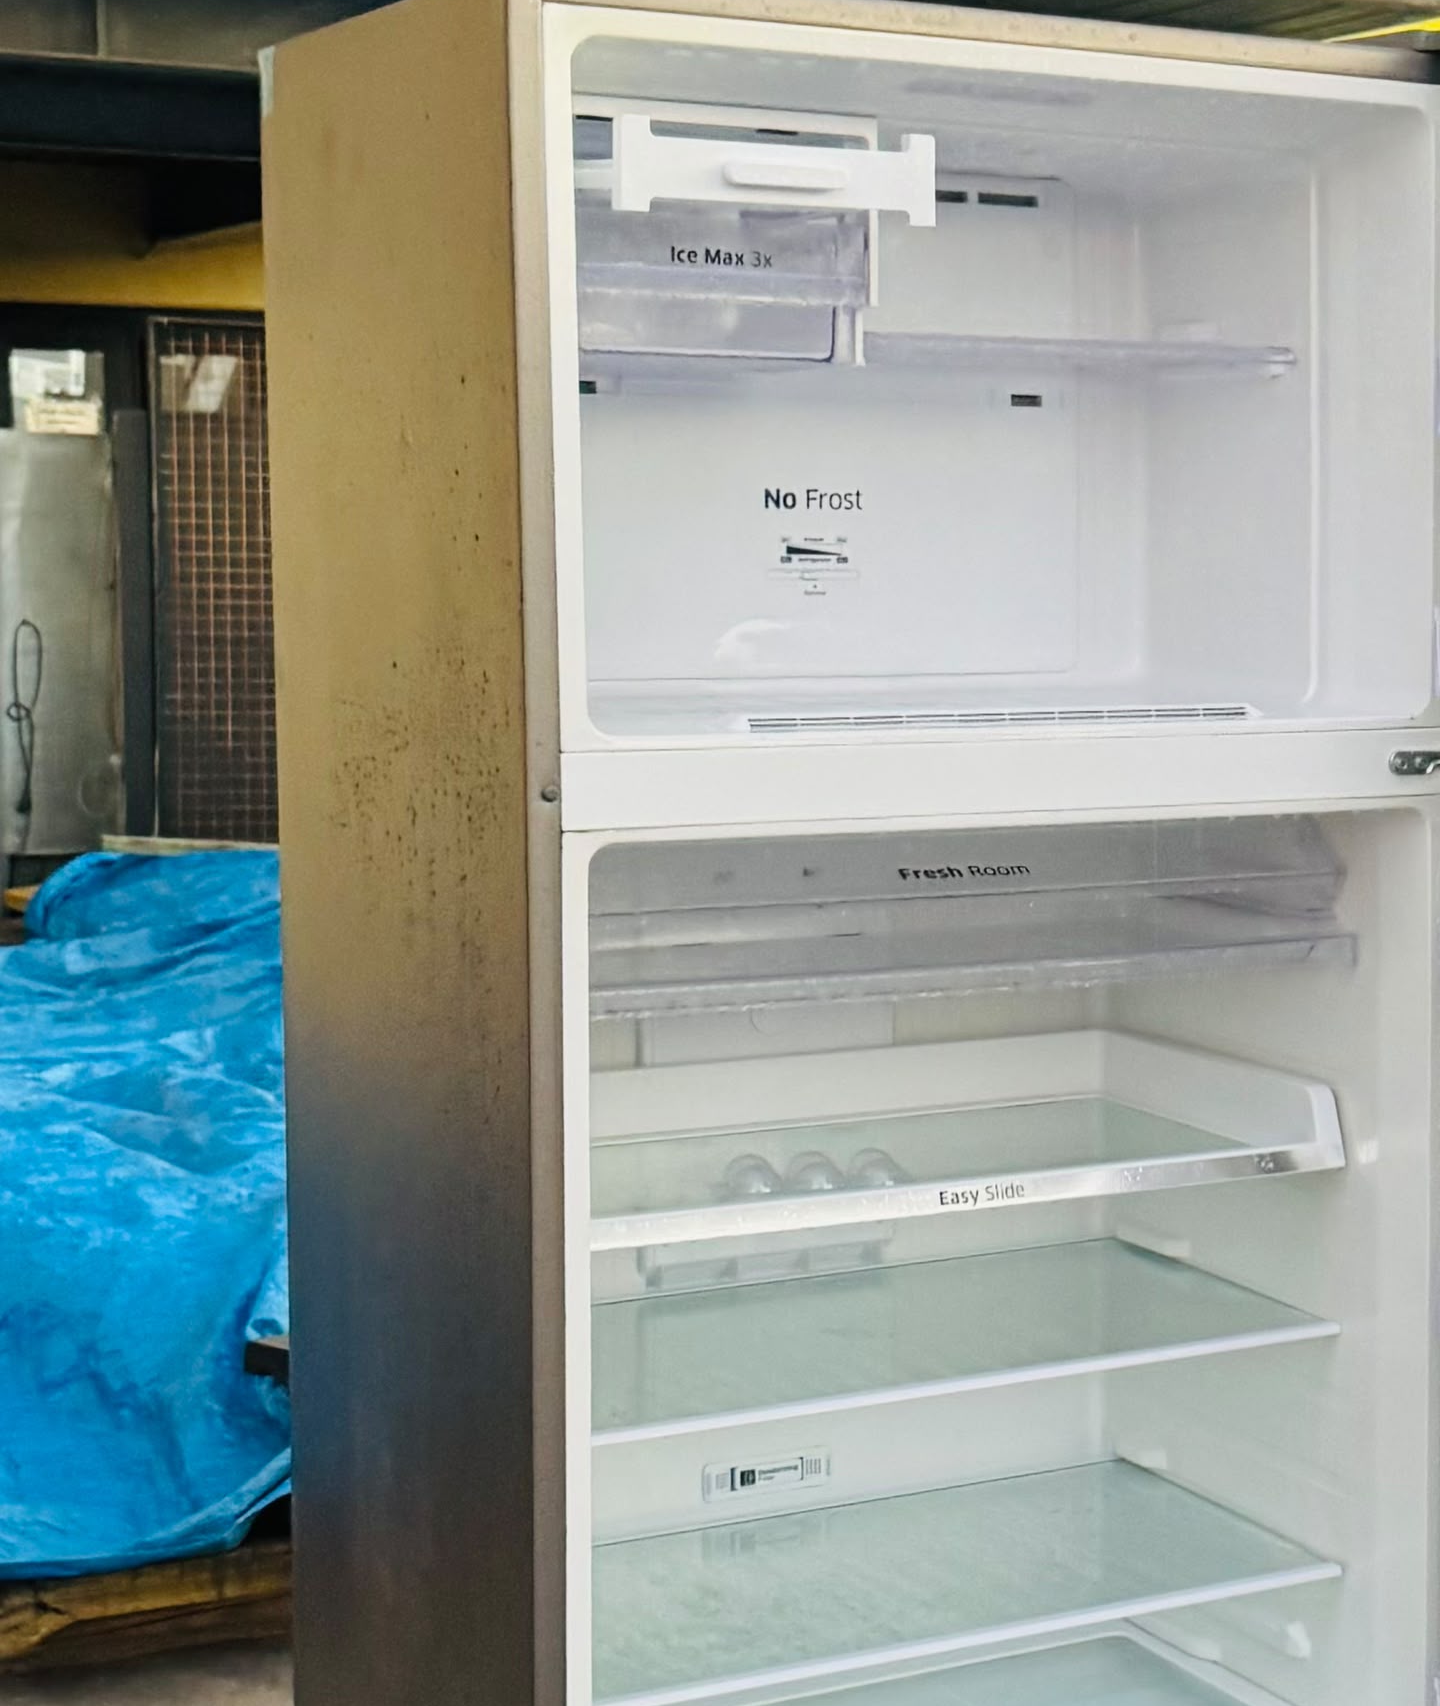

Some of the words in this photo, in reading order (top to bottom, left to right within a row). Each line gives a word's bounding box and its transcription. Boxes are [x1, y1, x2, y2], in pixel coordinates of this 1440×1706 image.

[670, 245, 698, 263] Ice
[705, 247, 744, 266] Max
[751, 250, 772, 268] 3x
[764, 488, 797, 510] No
[806, 488, 863, 510] Frost
[898, 866, 964, 880] Fresh
[967, 865, 1031, 877] Room
[939, 1190, 979, 1207] Easy
[984, 1181, 1025, 1202] Slide
